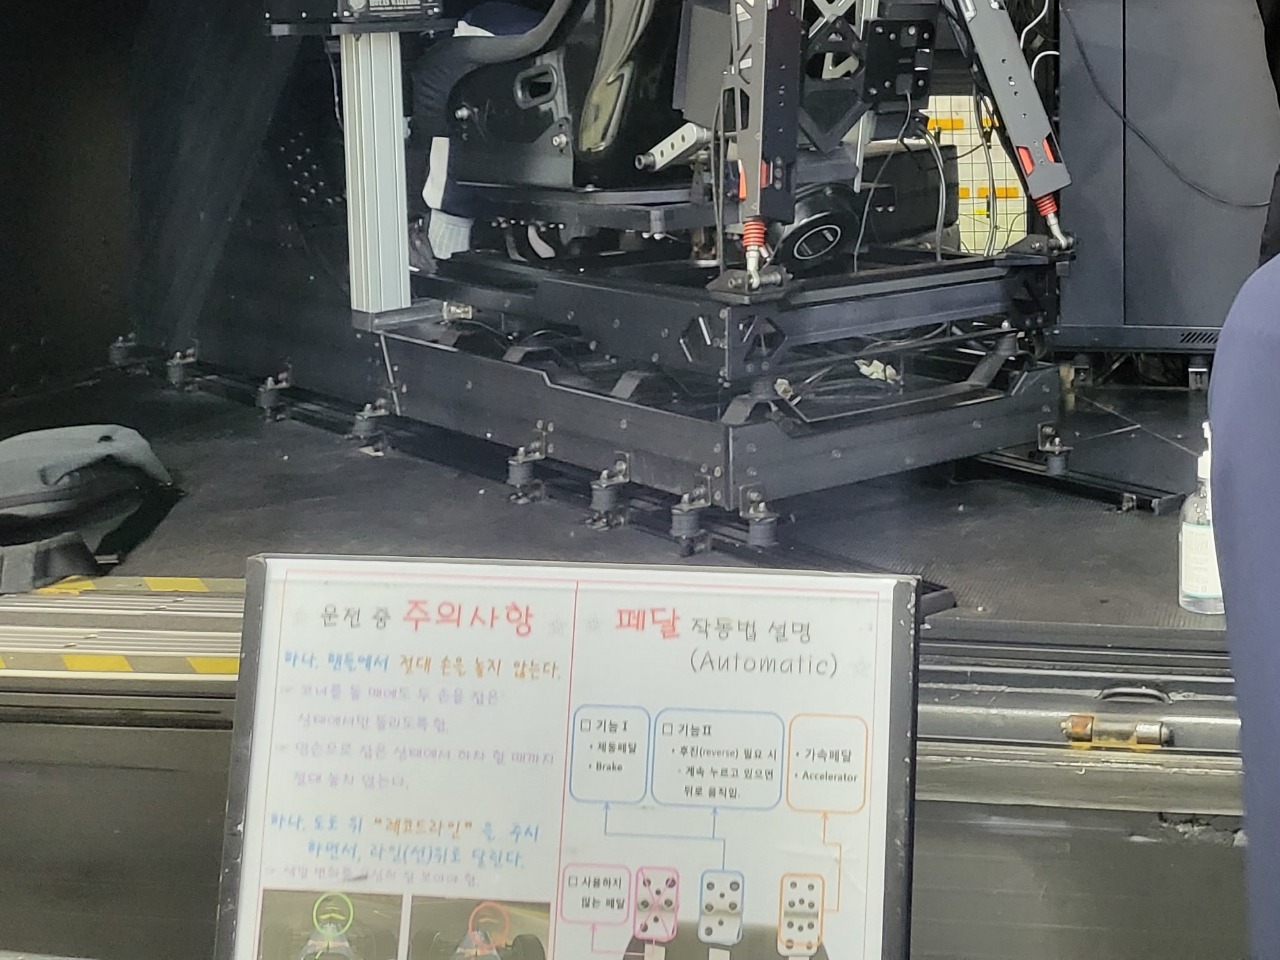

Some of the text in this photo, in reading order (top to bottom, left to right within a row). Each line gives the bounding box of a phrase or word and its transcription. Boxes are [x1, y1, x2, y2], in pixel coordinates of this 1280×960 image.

[321, 600, 533, 637] 운전 중 주의사항
[615, 606, 812, 644] 페달 작동법 설명
[400, 655, 431, 674] 절대
[441, 656, 466, 677] 손을
[690, 647, 838, 678] (Automatic)
[597, 741, 637, 755] 제동페달
[680, 745, 778, 762] 후진(reverse) 필요 시
[804, 748, 852, 764] 가속페달
[596, 761, 623, 772] Brake
[685, 765, 775, 781] 계속 누르고 있으면
[801, 770, 858, 783] Accelerator
[684, 785, 704, 798] 뒤로
[582, 876, 622, 889] 사용하지
[581, 897, 625, 910] 않는 페달
